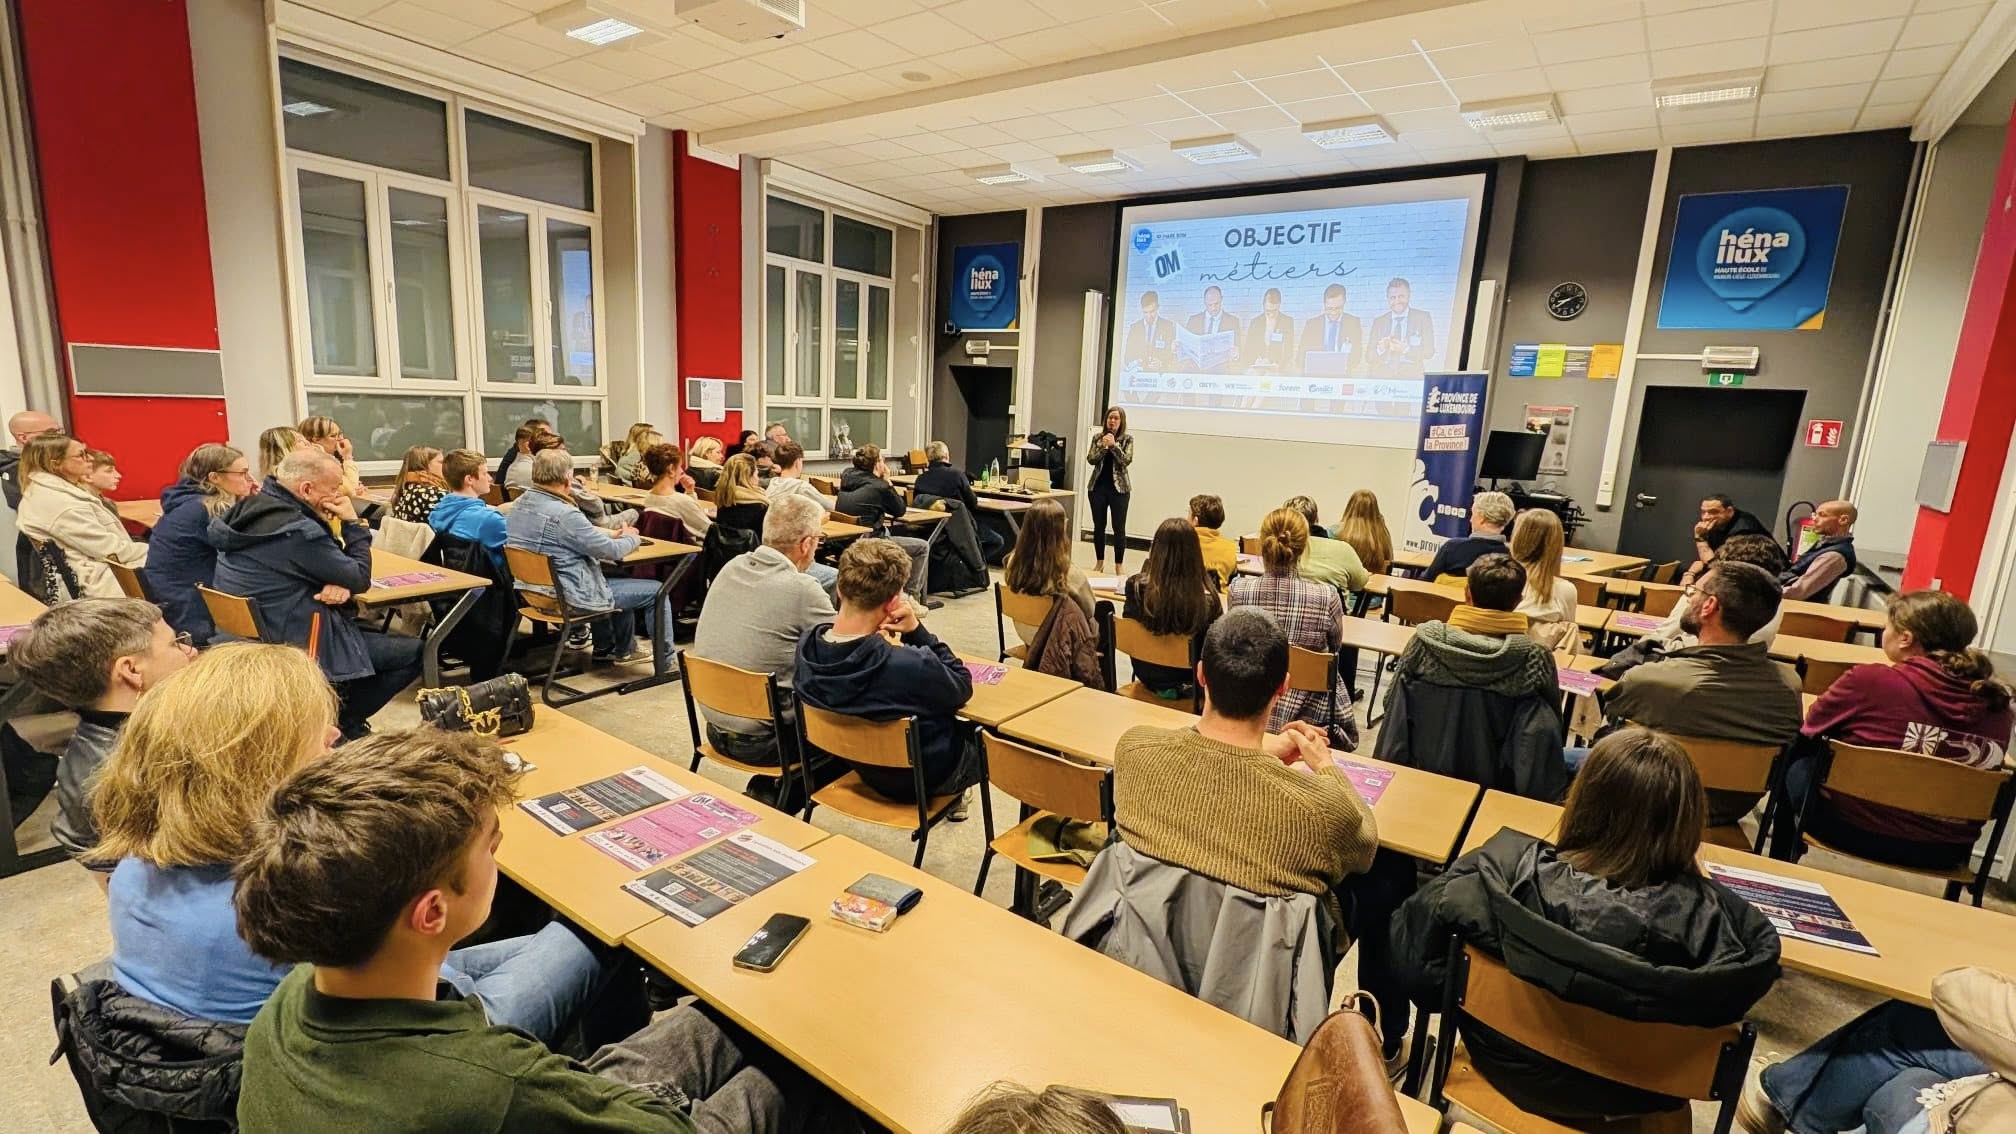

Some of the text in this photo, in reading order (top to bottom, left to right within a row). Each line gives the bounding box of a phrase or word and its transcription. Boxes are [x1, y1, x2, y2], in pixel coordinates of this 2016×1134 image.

[1224, 221, 1341, 248] OBJECTIF
[1720, 228, 1789, 248] héna
[1154, 250, 1180, 278] OM
[1200, 251, 1357, 281] métiers
[1716, 245, 1771, 264] llux
[971, 267, 999, 280] héna
